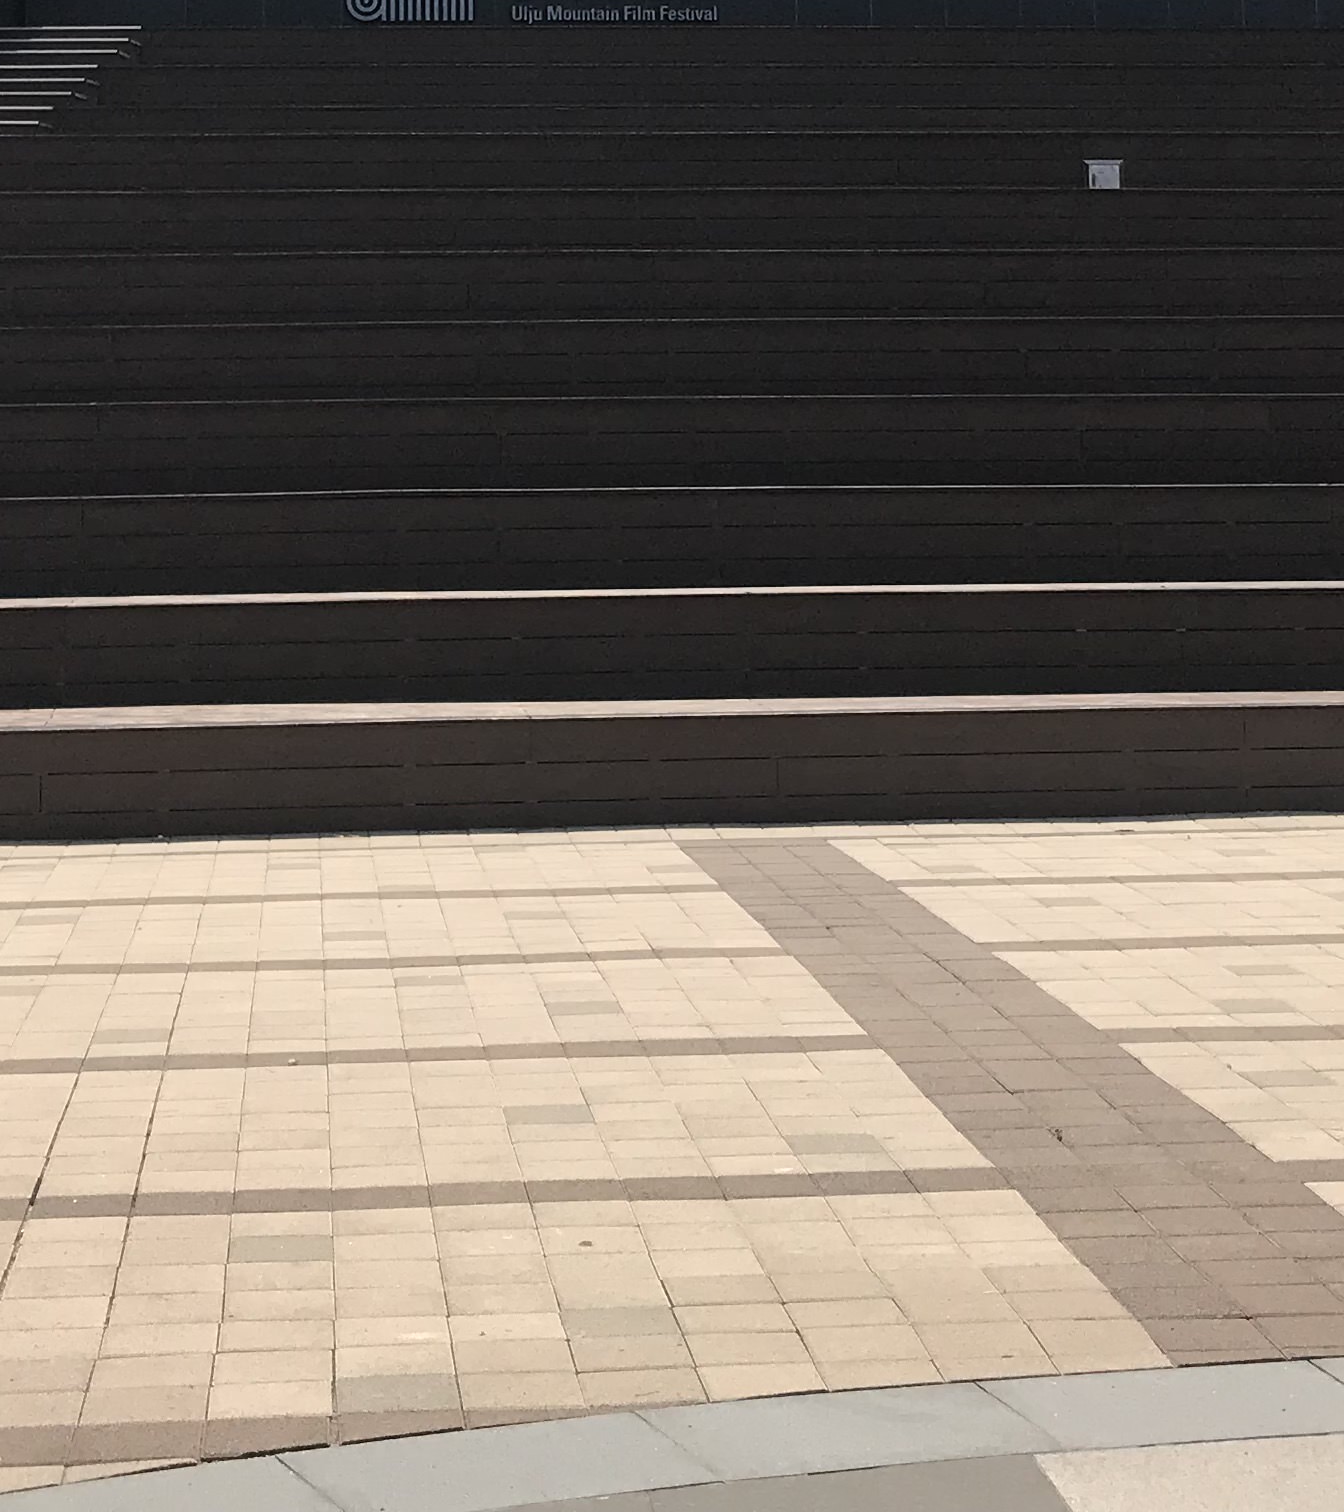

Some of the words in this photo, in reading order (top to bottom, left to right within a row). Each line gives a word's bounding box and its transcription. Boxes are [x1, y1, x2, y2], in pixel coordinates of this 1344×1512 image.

[511, 5, 543, 24] Ulju
[547, 5, 620, 21] Mountain
[624, 5, 656, 21] Film
[660, 5, 718, 21] Festival
